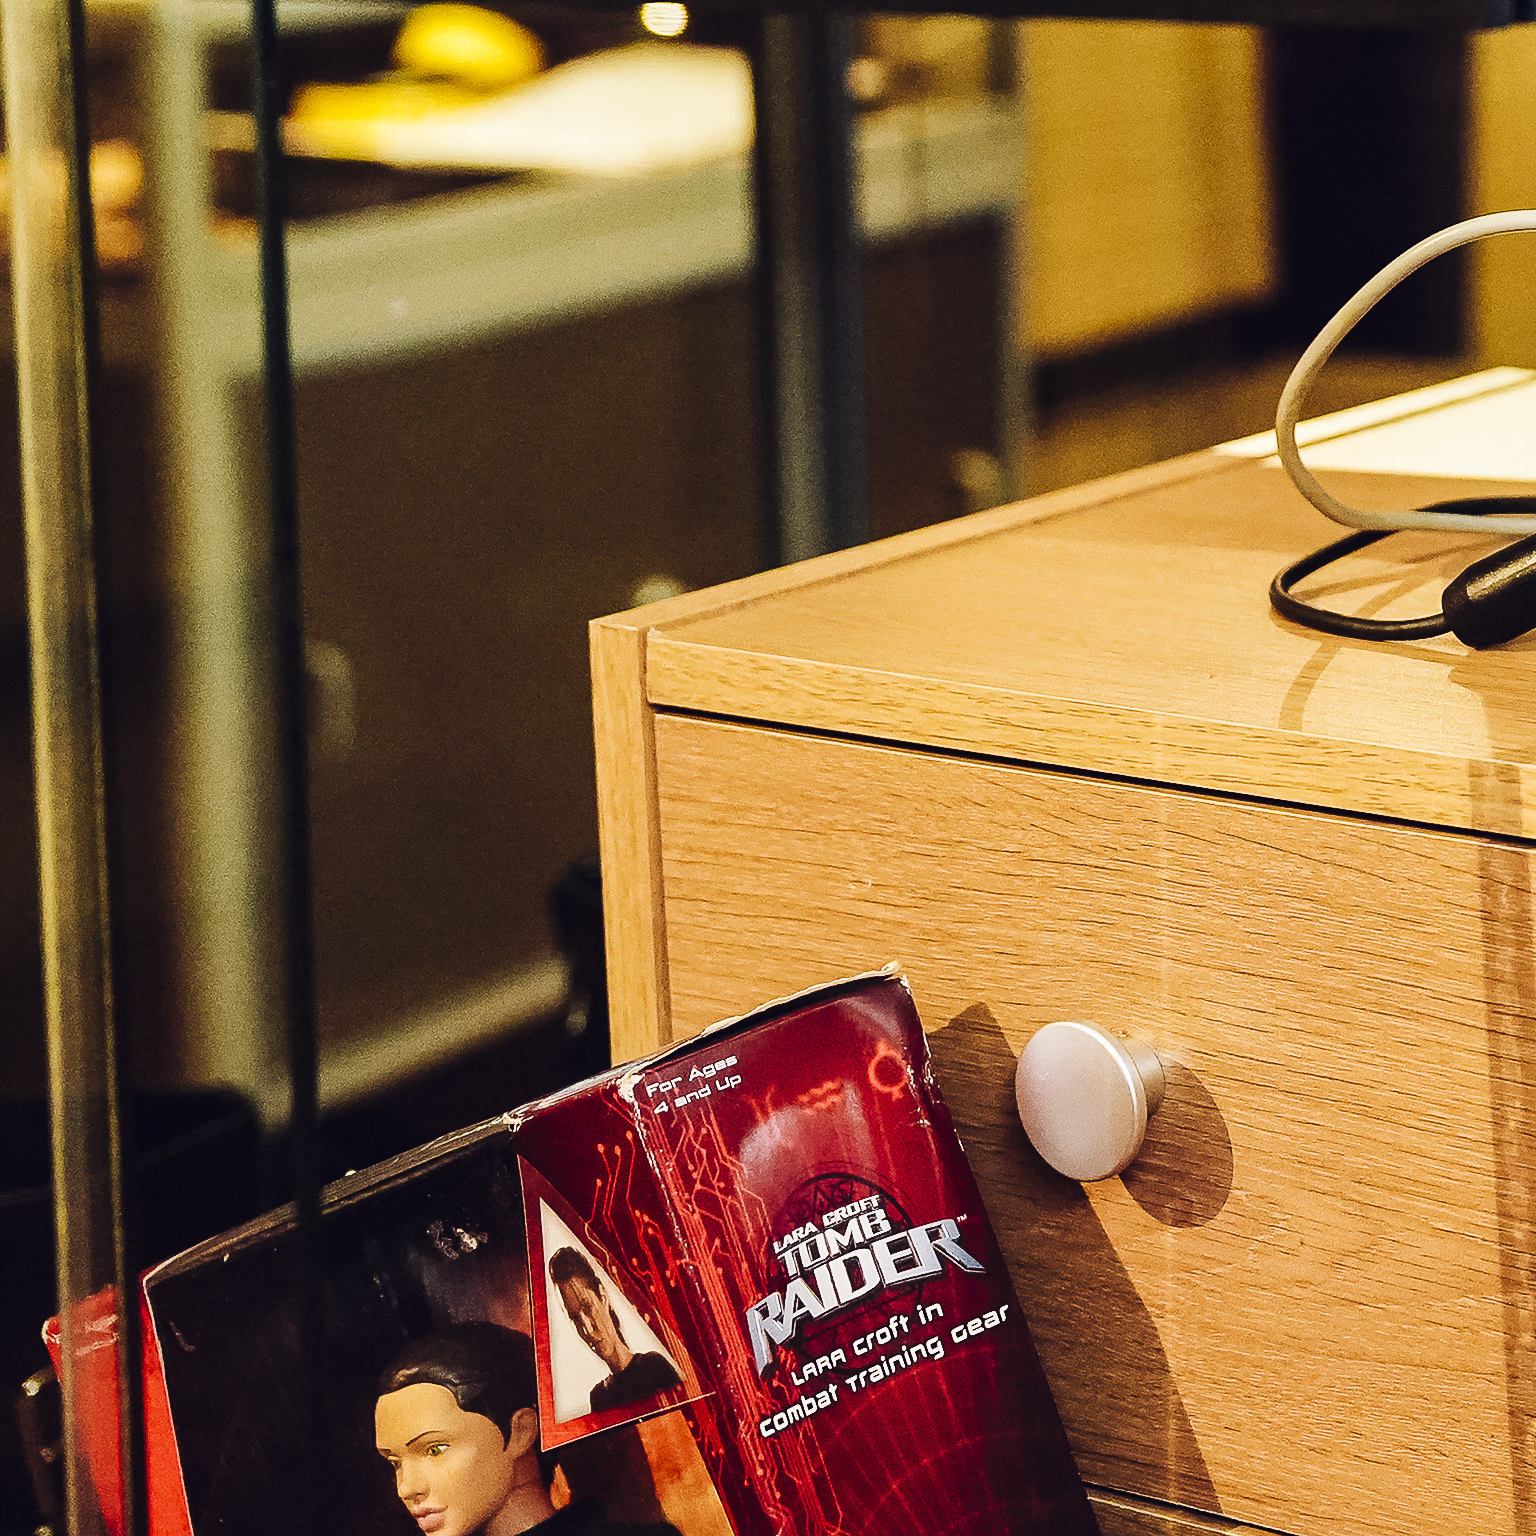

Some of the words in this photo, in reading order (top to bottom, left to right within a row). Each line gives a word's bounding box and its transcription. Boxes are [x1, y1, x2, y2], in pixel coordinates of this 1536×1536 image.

[646, 1073, 683, 1099] For
[688, 1054, 739, 1082] Ages
[653, 1099, 670, 1116] 4
[674, 1082, 712, 1109] and
[716, 1072, 743, 1096] Up
[773, 1220, 819, 1254] LARA
[822, 1194, 881, 1227] CROFT
[776, 1208, 892, 1279] TOMB
[746, 1218, 987, 1377] RAIDER
[790, 1347, 847, 1387] LARA
[916, 1302, 945, 1326] in
